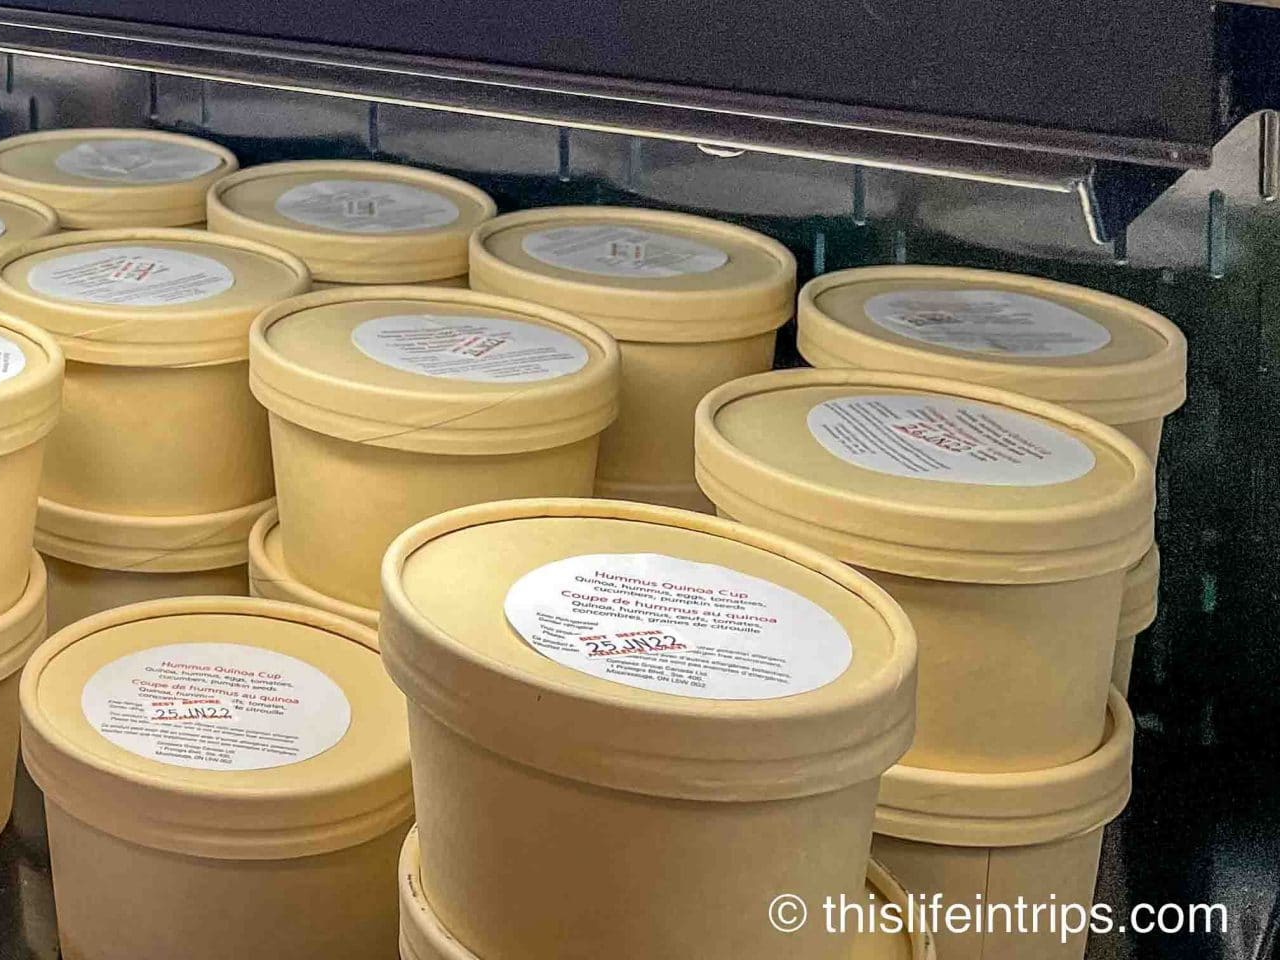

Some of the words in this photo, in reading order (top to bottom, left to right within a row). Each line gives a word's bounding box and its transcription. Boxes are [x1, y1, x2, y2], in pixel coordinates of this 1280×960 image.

[574, 576, 618, 588] Quinoa,
[621, 583, 672, 596] hummus,
[676, 592, 706, 601] eggs,
[710, 596, 767, 608] tomatoes,
[594, 570, 658, 587] Hummus
[662, 582, 714, 594] Quinoa
[718, 589, 749, 599] Cup
[560, 590, 608, 603] Coupe
[612, 598, 630, 606] de
[634, 600, 698, 615] hummus
[726, 612, 778, 624] quinoa
[594, 586, 657, 600] cucumbers,
[660, 596, 710, 607] pumpkin
[714, 602, 746, 610] seeds
[572, 600, 615, 611] Quinoa,
[619, 606, 672, 619] hummus,
[712, 618, 762, 628] tomates,
[572, 608, 644, 622] concombres,
[648, 618, 690, 626] graines
[710, 624, 761, 634] citrouille
[615, 630, 663, 638] BEFORE
[145, 667, 179, 675] Quinoa,
[250, 679, 294, 688] tomatoes,
[161, 661, 210, 671] Hummus
[214, 666, 255, 677] Quinoa
[258, 671, 281, 679] Cup
[132, 679, 169, 689] Coupe
[189, 685, 239, 698] hummus
[259, 695, 300, 704] quinoa
[210, 680, 250, 689] pumpkin
[246, 707, 284, 715] citrouille
